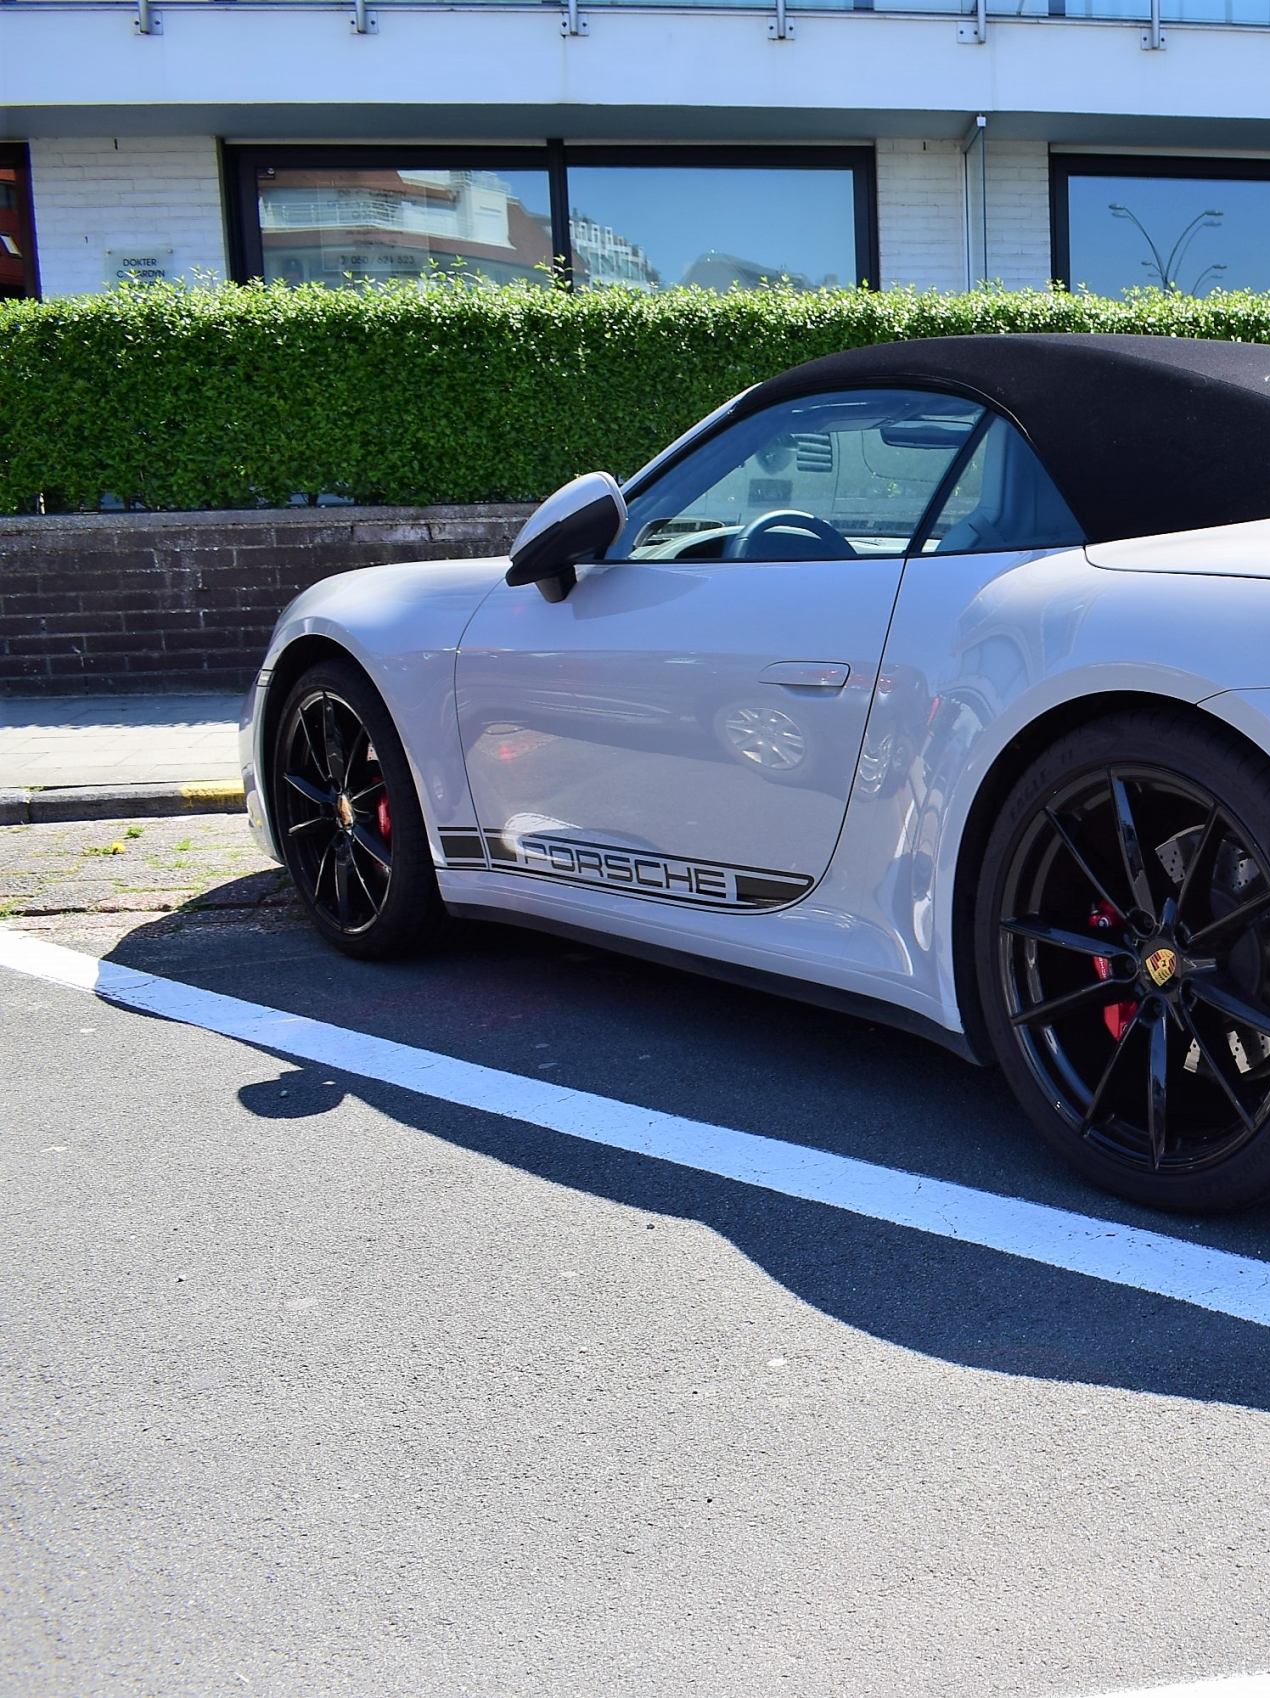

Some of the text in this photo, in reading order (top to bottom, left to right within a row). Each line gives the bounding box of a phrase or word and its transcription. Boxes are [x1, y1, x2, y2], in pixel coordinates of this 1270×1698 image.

[123, 258, 157, 267] DOKTER
[128, 269, 165, 278] ARDYN
[522, 840, 727, 898] PORSCHE
